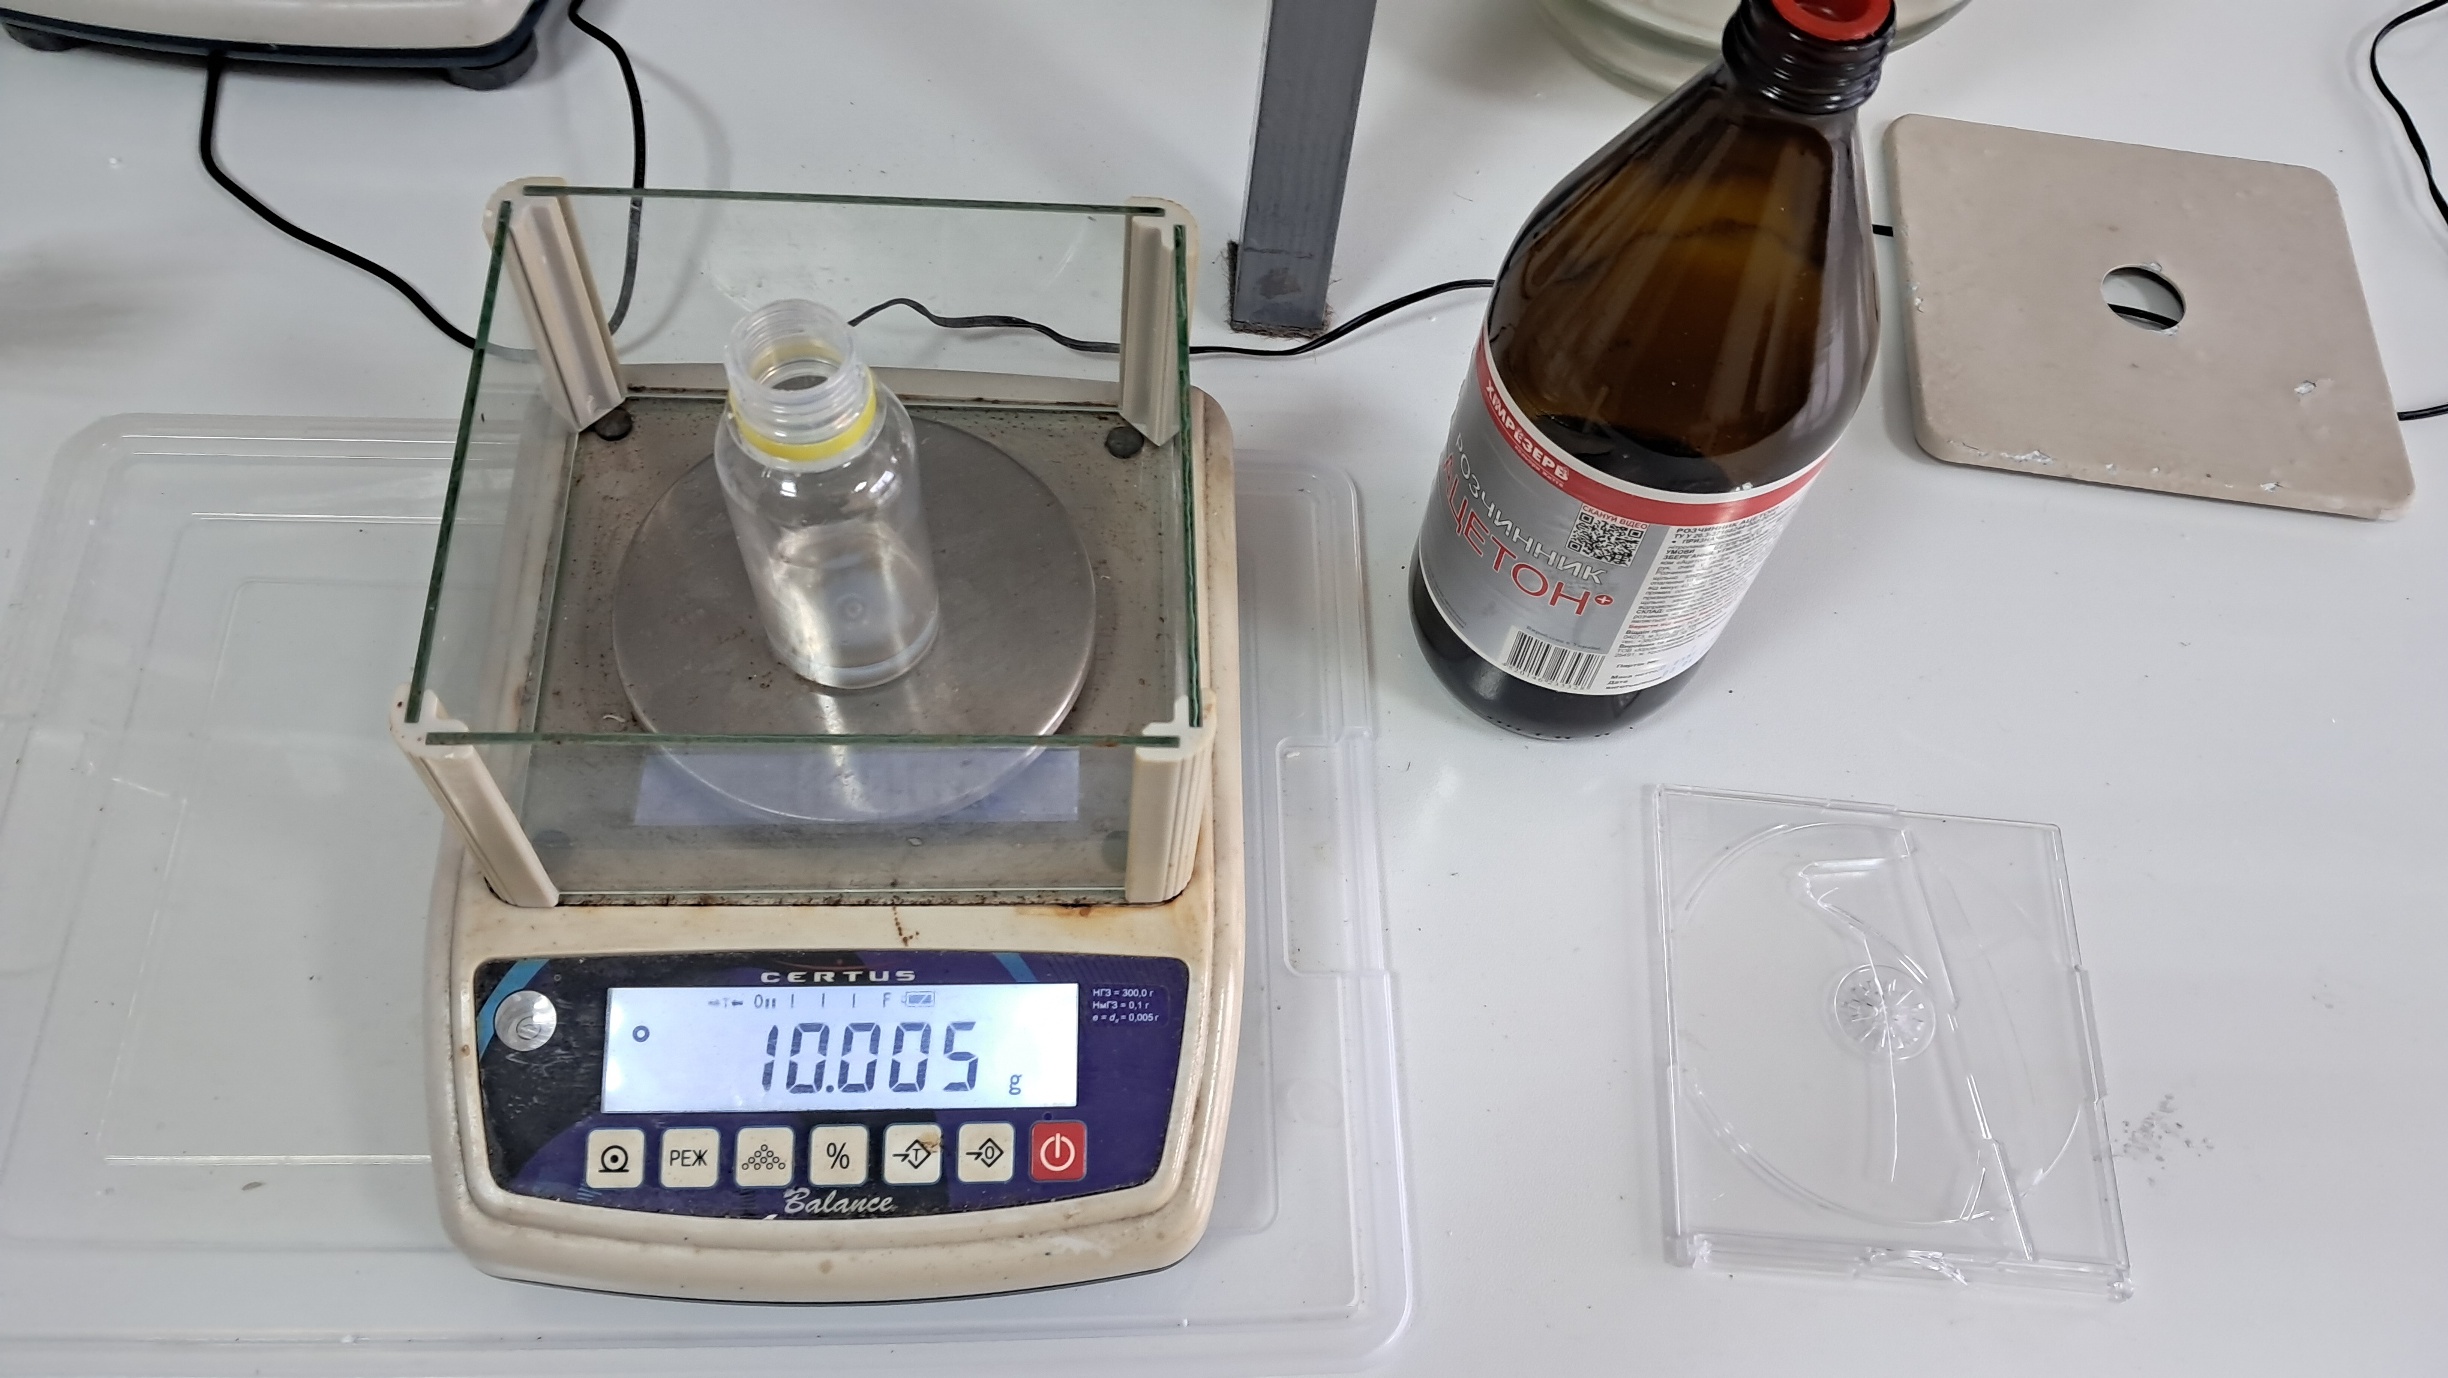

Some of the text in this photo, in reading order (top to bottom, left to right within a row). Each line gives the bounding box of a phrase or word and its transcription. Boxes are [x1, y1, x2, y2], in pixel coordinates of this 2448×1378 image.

[1455, 432, 1608, 584] РОЗЧИННИК
[1619, 518, 1648, 530] ВІДЕО
[760, 970, 916, 983] CERTUS
[1092, 988, 1112, 997] НГЗ
[1122, 988, 1148, 998] 300,0
[1128, 1001, 1142, 1010] 0,1
[1128, 1013, 1154, 1022] 0,005
[762, 1021, 1023, 1095] 10.005 g
[669, 1148, 708, 1167] РЕЖ
[783, 1187, 895, 1214] Balance
